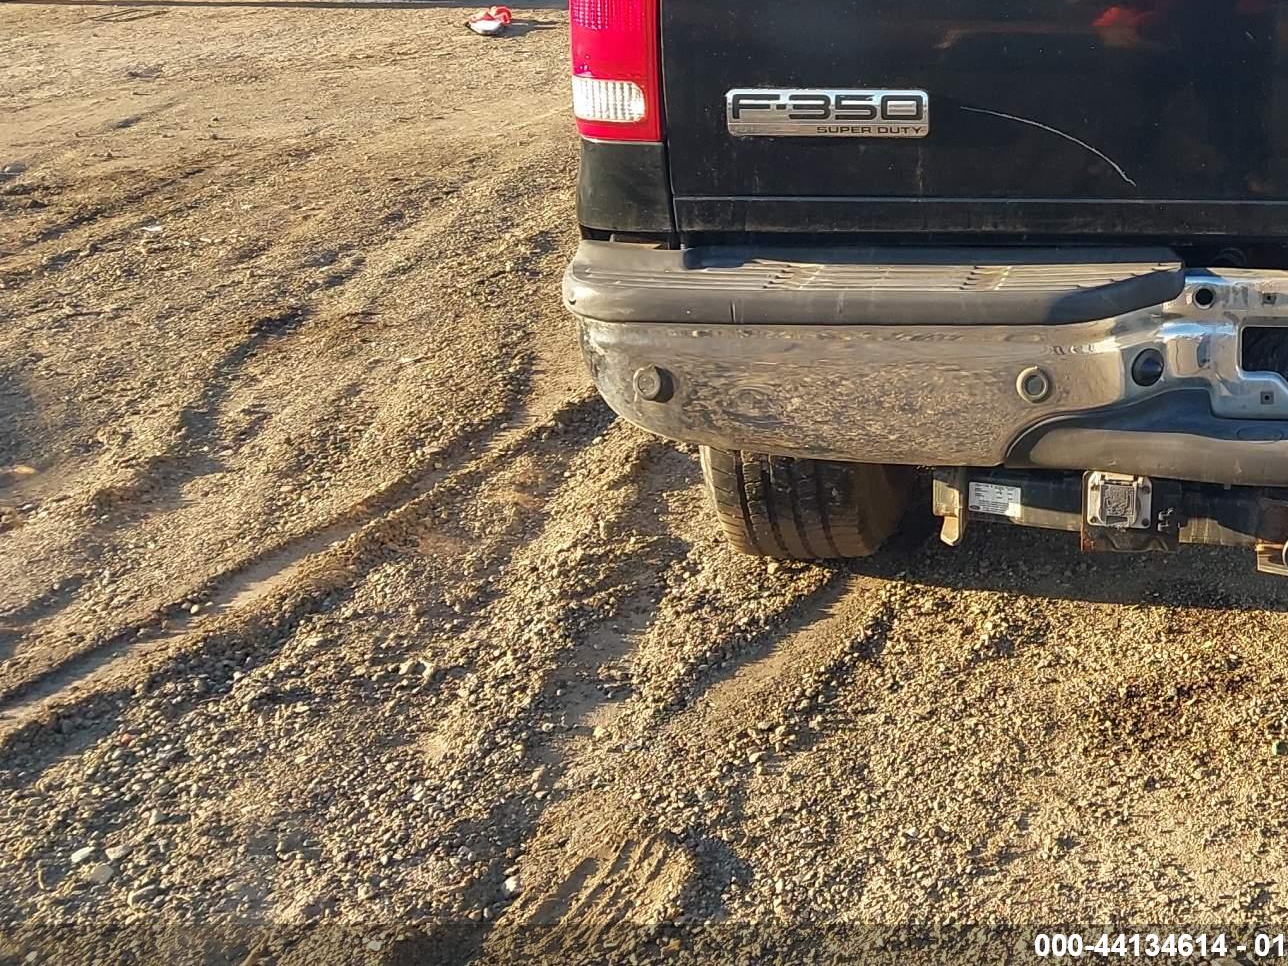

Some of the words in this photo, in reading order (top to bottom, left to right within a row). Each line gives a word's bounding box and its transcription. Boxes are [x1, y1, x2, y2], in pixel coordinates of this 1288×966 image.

[732, 93, 924, 121] F-350
[816, 126, 872, 135] SUPER
[877, 126, 922, 135] DUTY
